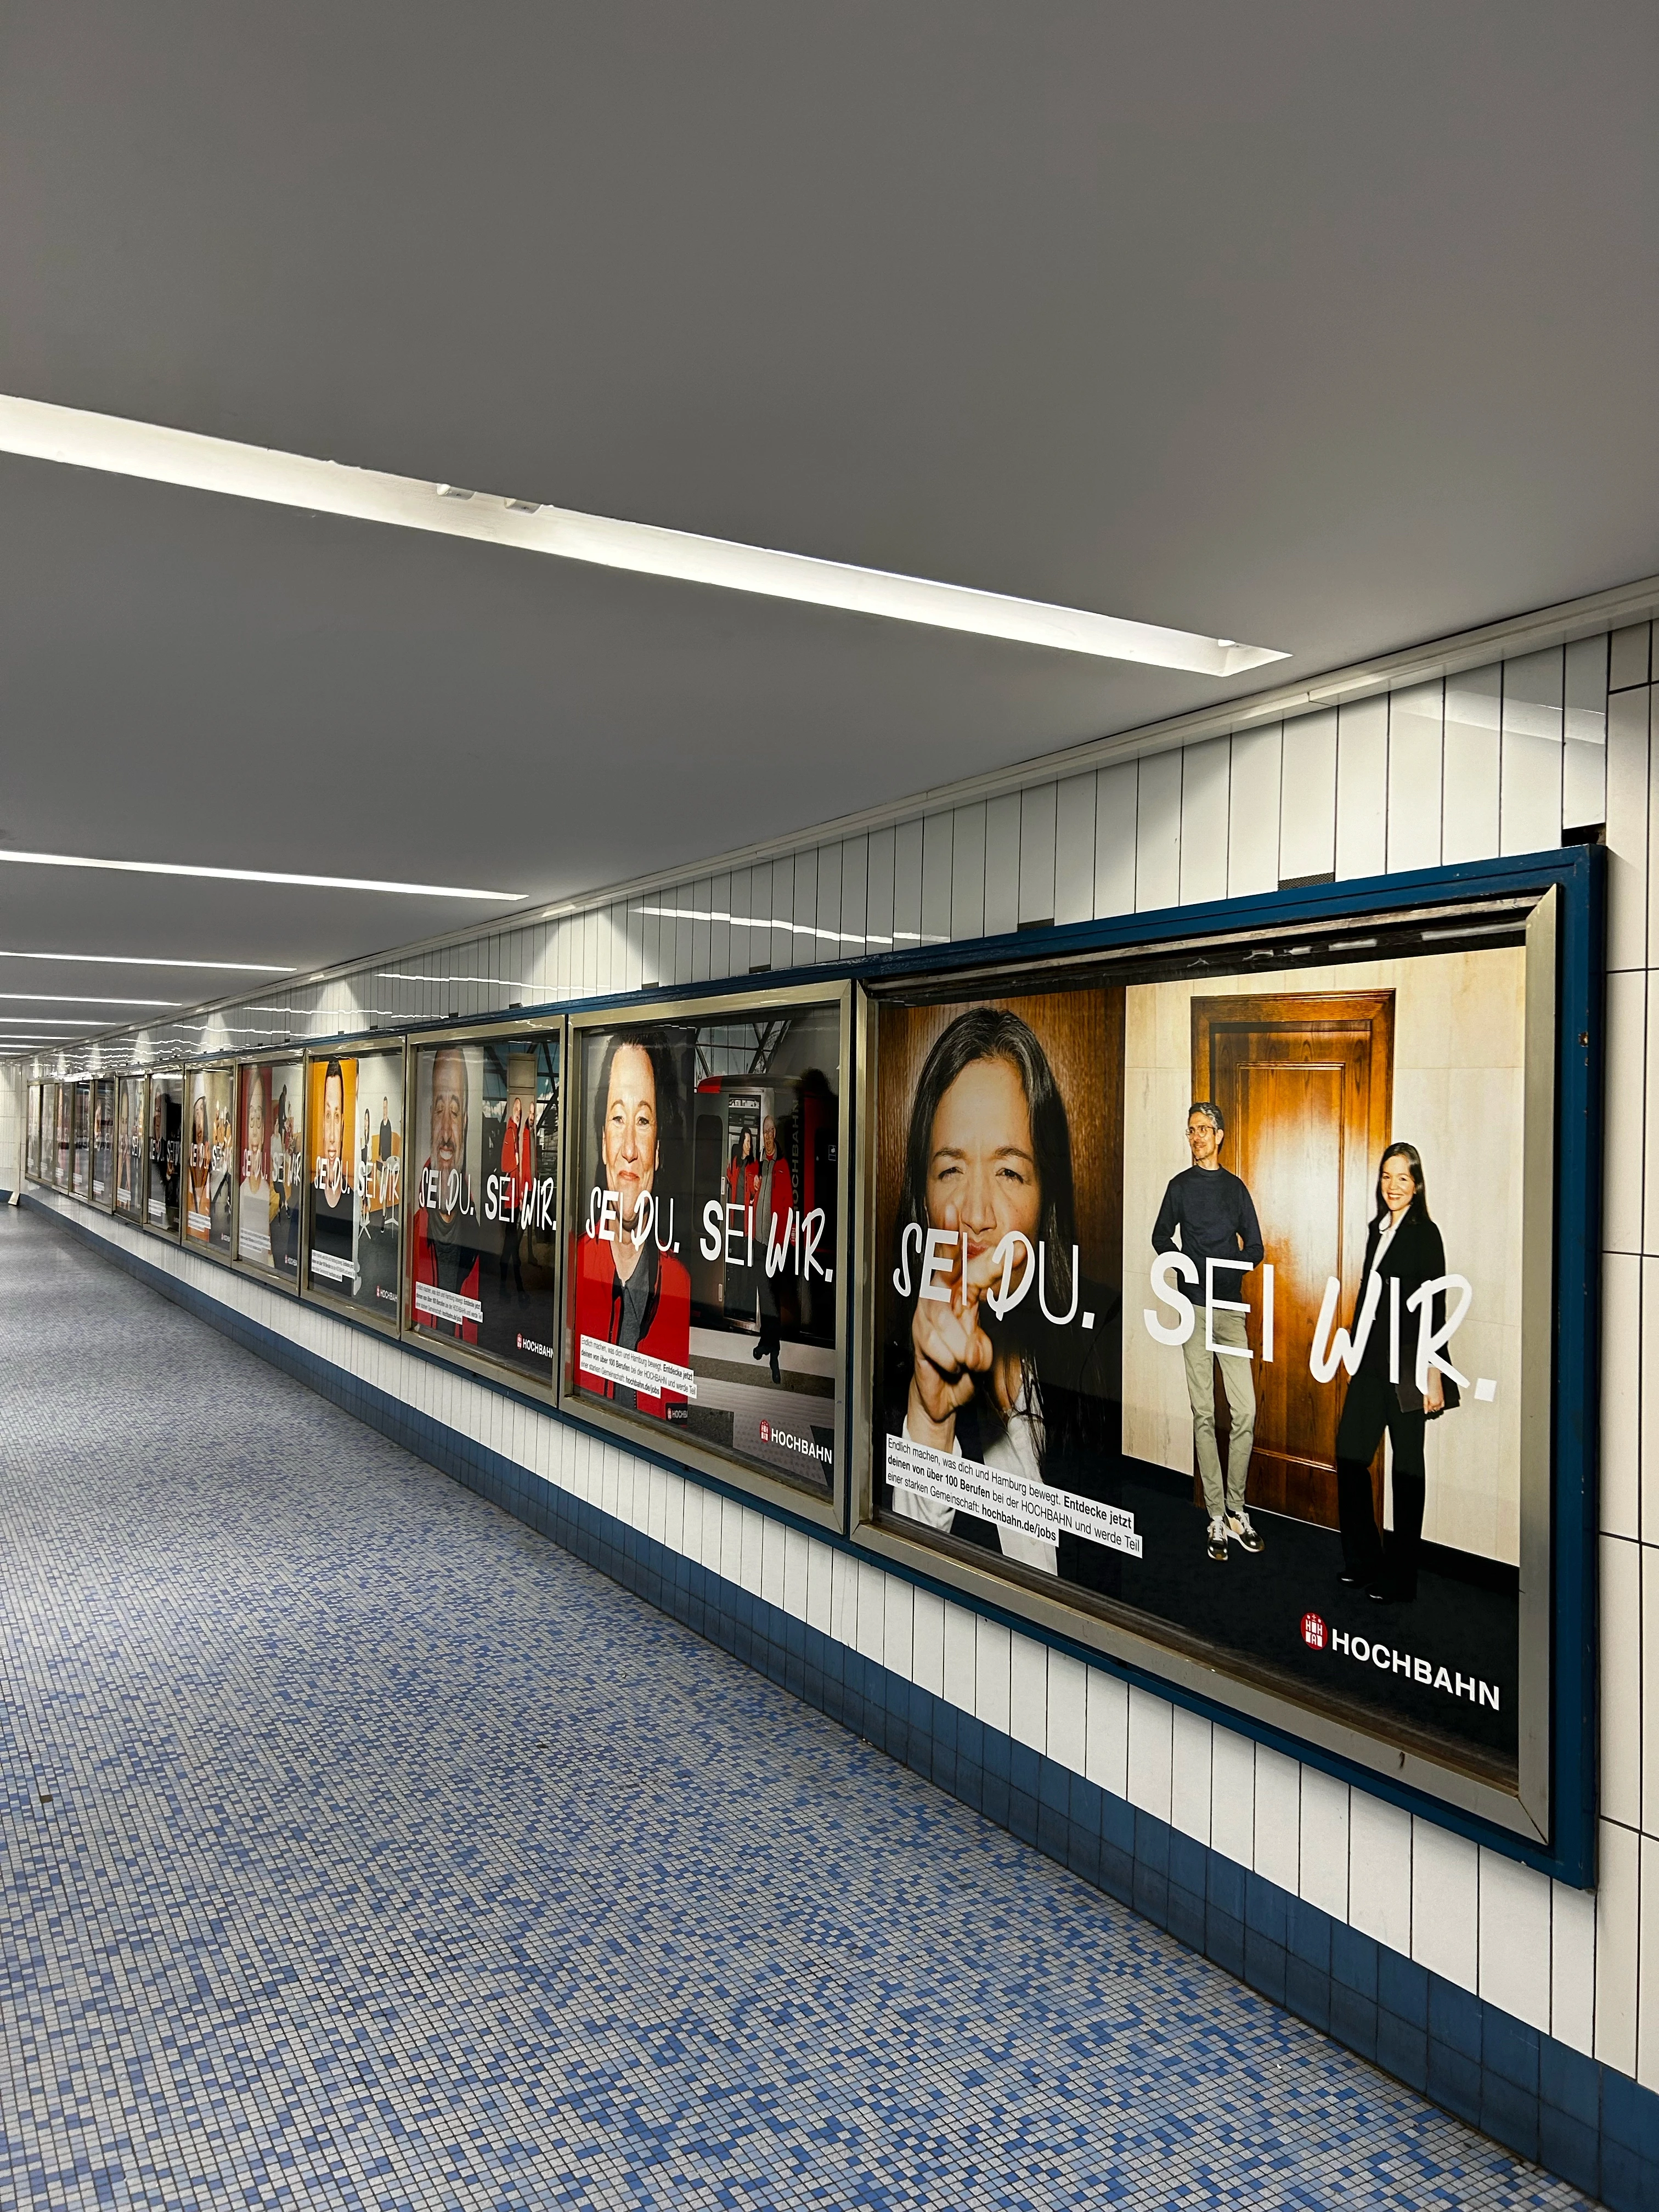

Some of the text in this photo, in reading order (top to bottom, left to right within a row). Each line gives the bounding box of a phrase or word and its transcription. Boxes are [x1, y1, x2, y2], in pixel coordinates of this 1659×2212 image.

[314, 1156, 330, 1190] SEI
[331, 1156, 351, 1195] DU.
[357, 1160, 376, 1199] SEI
[419, 1167, 557, 1231] SEI DU. SEI WIR.
[585, 1186, 833, 1283] SEI DU. SEI WIR.
[893, 1222, 1497, 1402] SEI DU. SEI WIR.
[771, 1427, 832, 1464] HOCHBAHN
[888, 1437, 1132, 1530] Endlich machen, was dich und Hamburg bewegt. Entdecke jetzt
[888, 1454, 1140, 1552] deinen von über 100 Berufen bei der HOCHBAHN und werde Teil
[888, 1471, 1056, 1542] einer starken Gemeinschaft: hochbahn.de/jobs
[1332, 1628, 1499, 1711] HOCHBAHN
